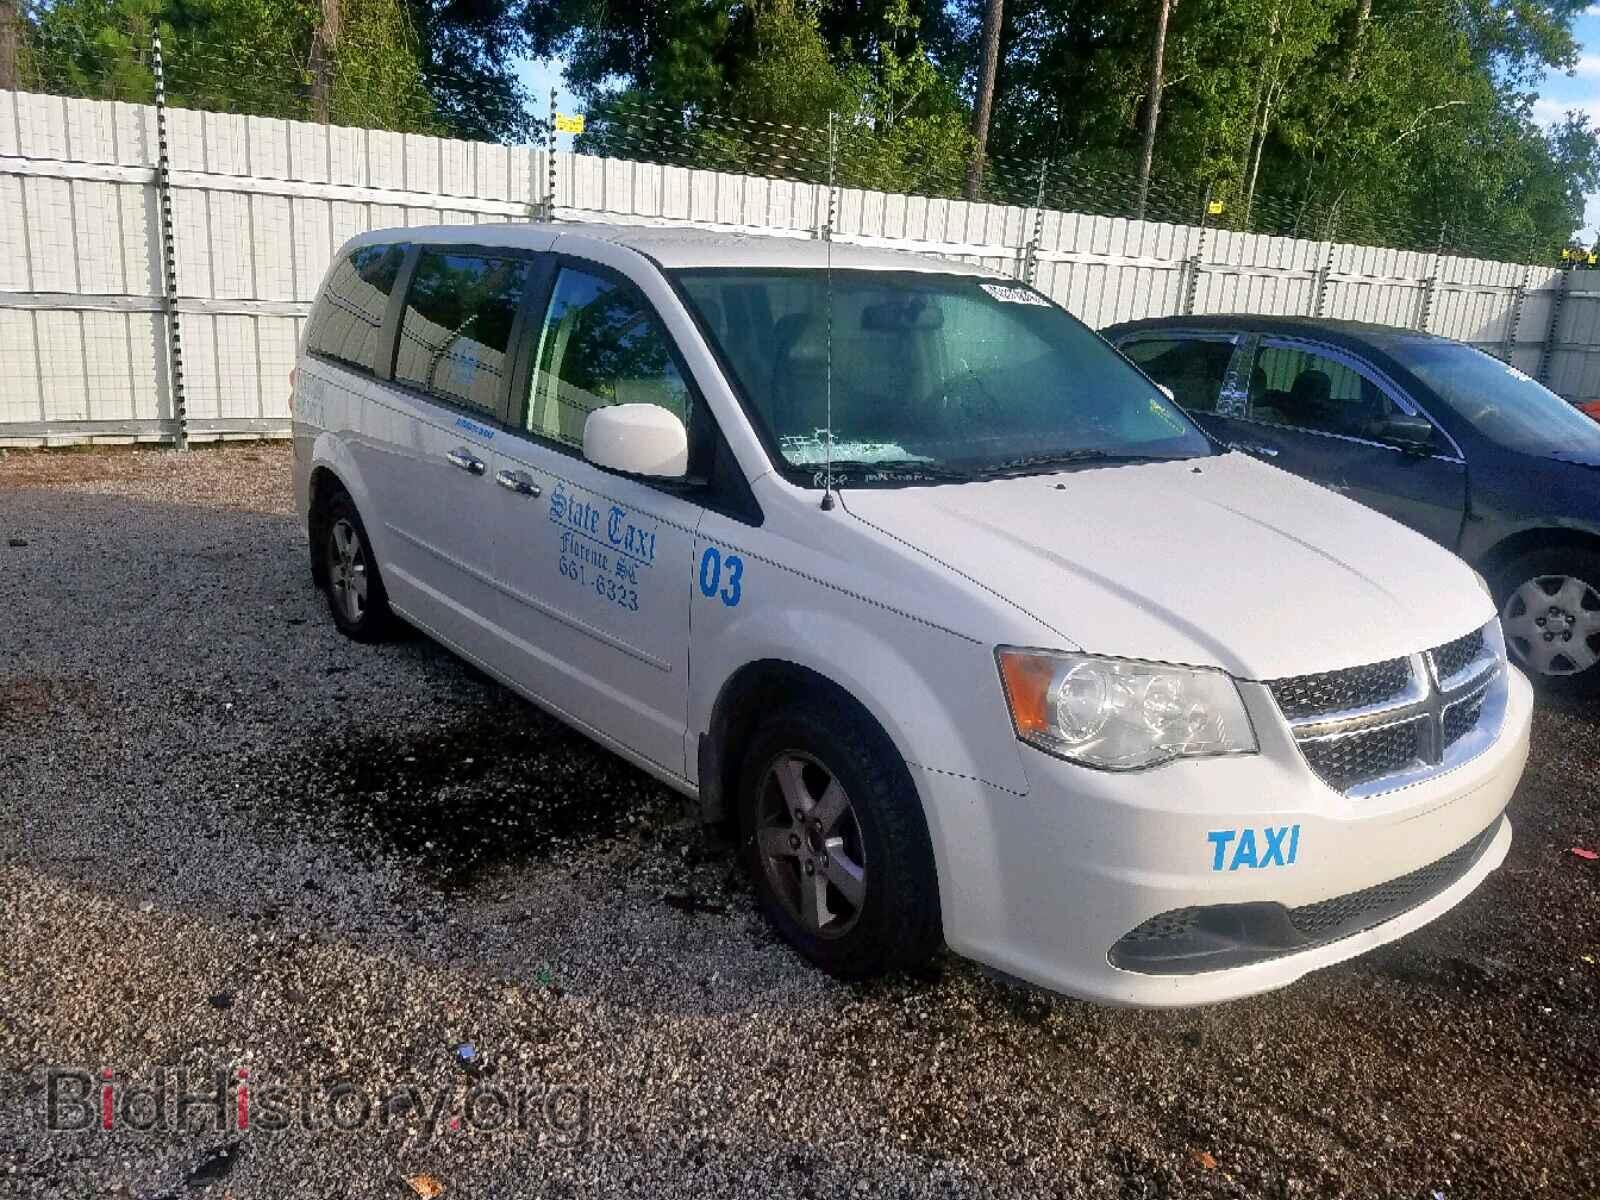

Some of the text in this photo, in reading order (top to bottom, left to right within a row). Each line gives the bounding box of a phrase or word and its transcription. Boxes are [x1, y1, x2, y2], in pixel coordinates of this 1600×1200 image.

[550, 484, 657, 560] State Taxi
[559, 556, 639, 611] 661-6323
[616, 557, 639, 585] SC
[700, 547, 743, 606] 03
[1207, 824, 1300, 871] TAXI
